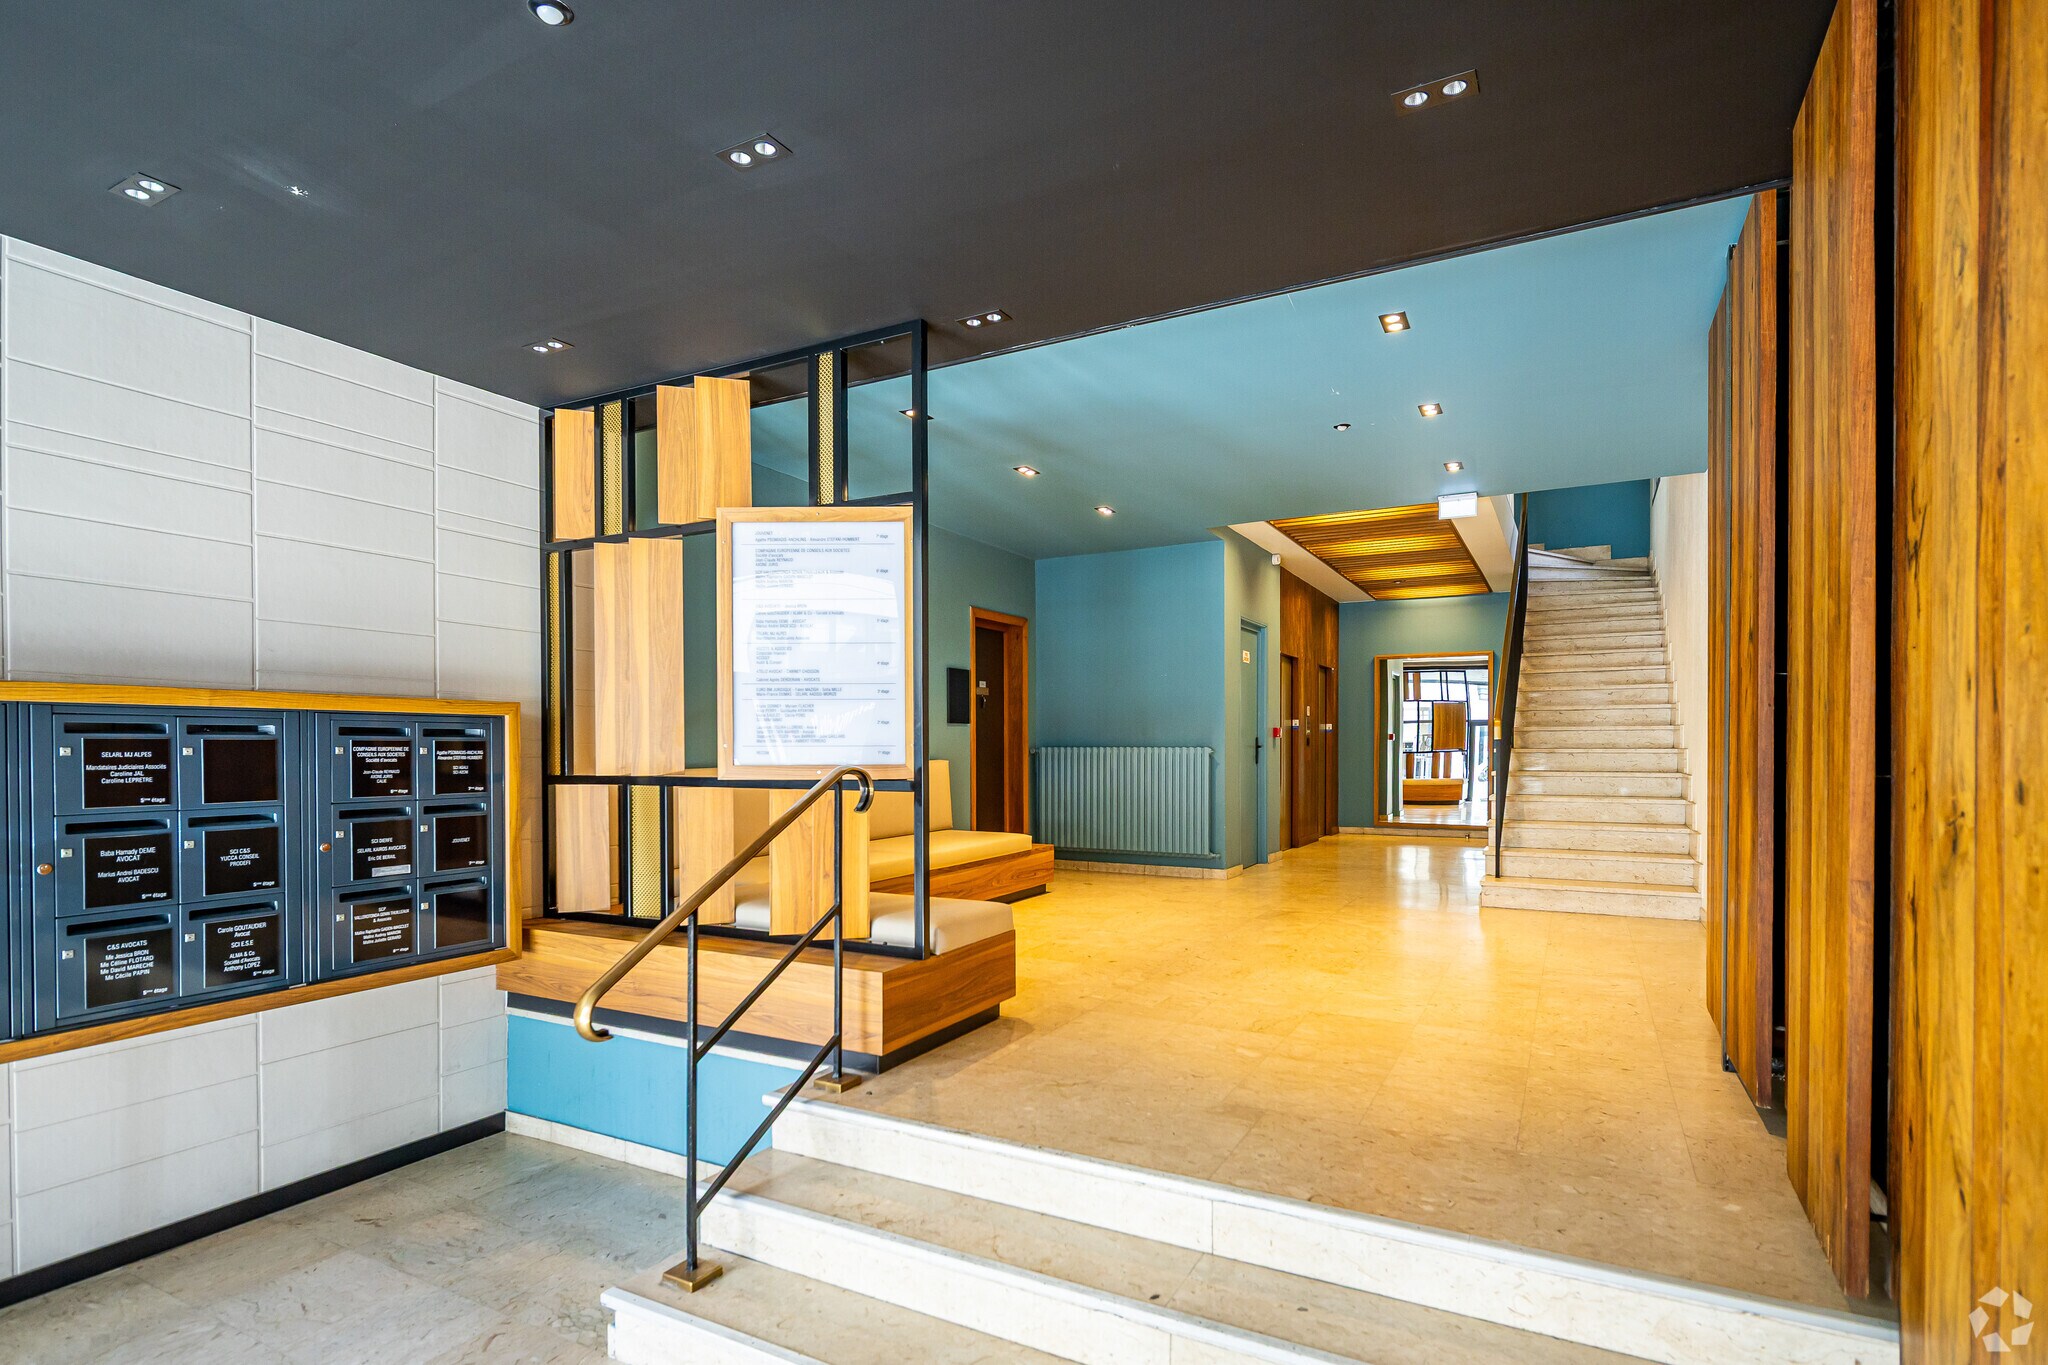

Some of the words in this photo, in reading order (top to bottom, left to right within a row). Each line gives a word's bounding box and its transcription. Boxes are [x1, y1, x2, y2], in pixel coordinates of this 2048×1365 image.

[115, 848, 138, 856] Hamady
[139, 846, 156, 854] DEME
[116, 869, 133, 877] Andrei
[133, 867, 159, 875] BADESCU
[106, 943, 120, 951] C&S
[120, 940, 148, 949] AVOCATS
[114, 952, 133, 960] Jessica
[133, 949, 149, 957] BRON
[128, 955, 154, 963] FLOTARD
[110, 966, 126, 974] David
[223, 964, 244, 972] Anthony
[244, 961, 261, 969] LOPEZ
[132, 969, 150, 977] PAPIN
